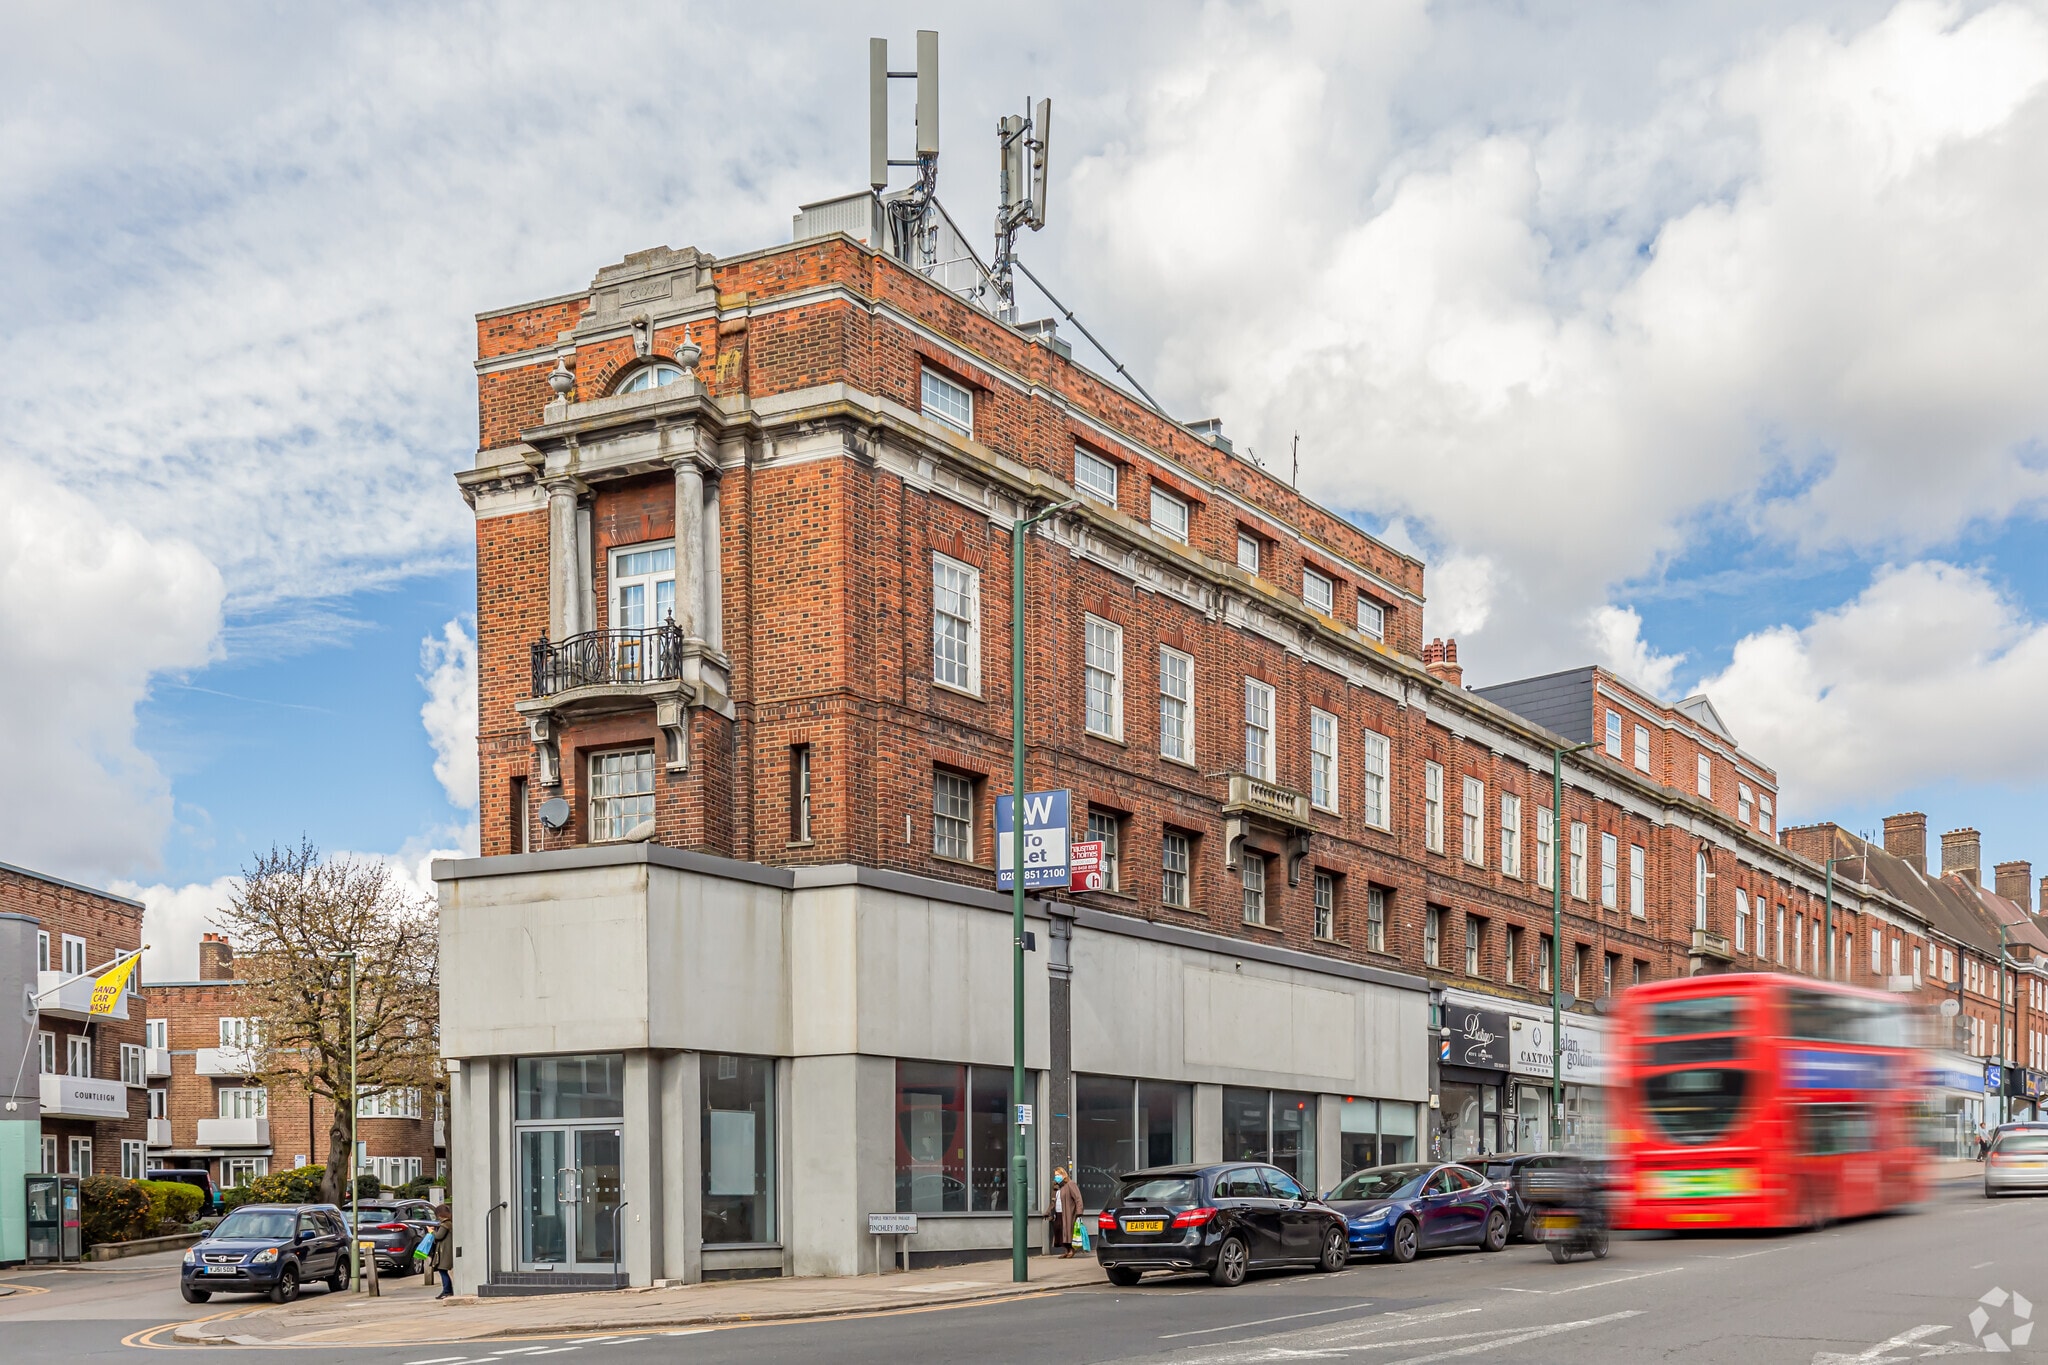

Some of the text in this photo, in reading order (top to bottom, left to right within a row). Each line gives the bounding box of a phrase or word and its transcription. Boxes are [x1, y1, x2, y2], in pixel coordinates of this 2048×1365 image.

[1024, 833, 1042, 847] To
[1077, 851, 1098, 859] holmes
[1024, 870, 1040, 879] 851
[1043, 868, 1065, 878] 2100
[1092, 875, 1100, 887] h
[93, 985, 116, 994] HAND
[93, 994, 109, 1002] CAR
[1560, 1033, 1578, 1053] alan
[1520, 1050, 1554, 1065] CAXTON
[1525, 1066, 1549, 1074] LONDON
[74, 1091, 115, 1102] COURTLEIGH
[1130, 1222, 1145, 1230] EA18
